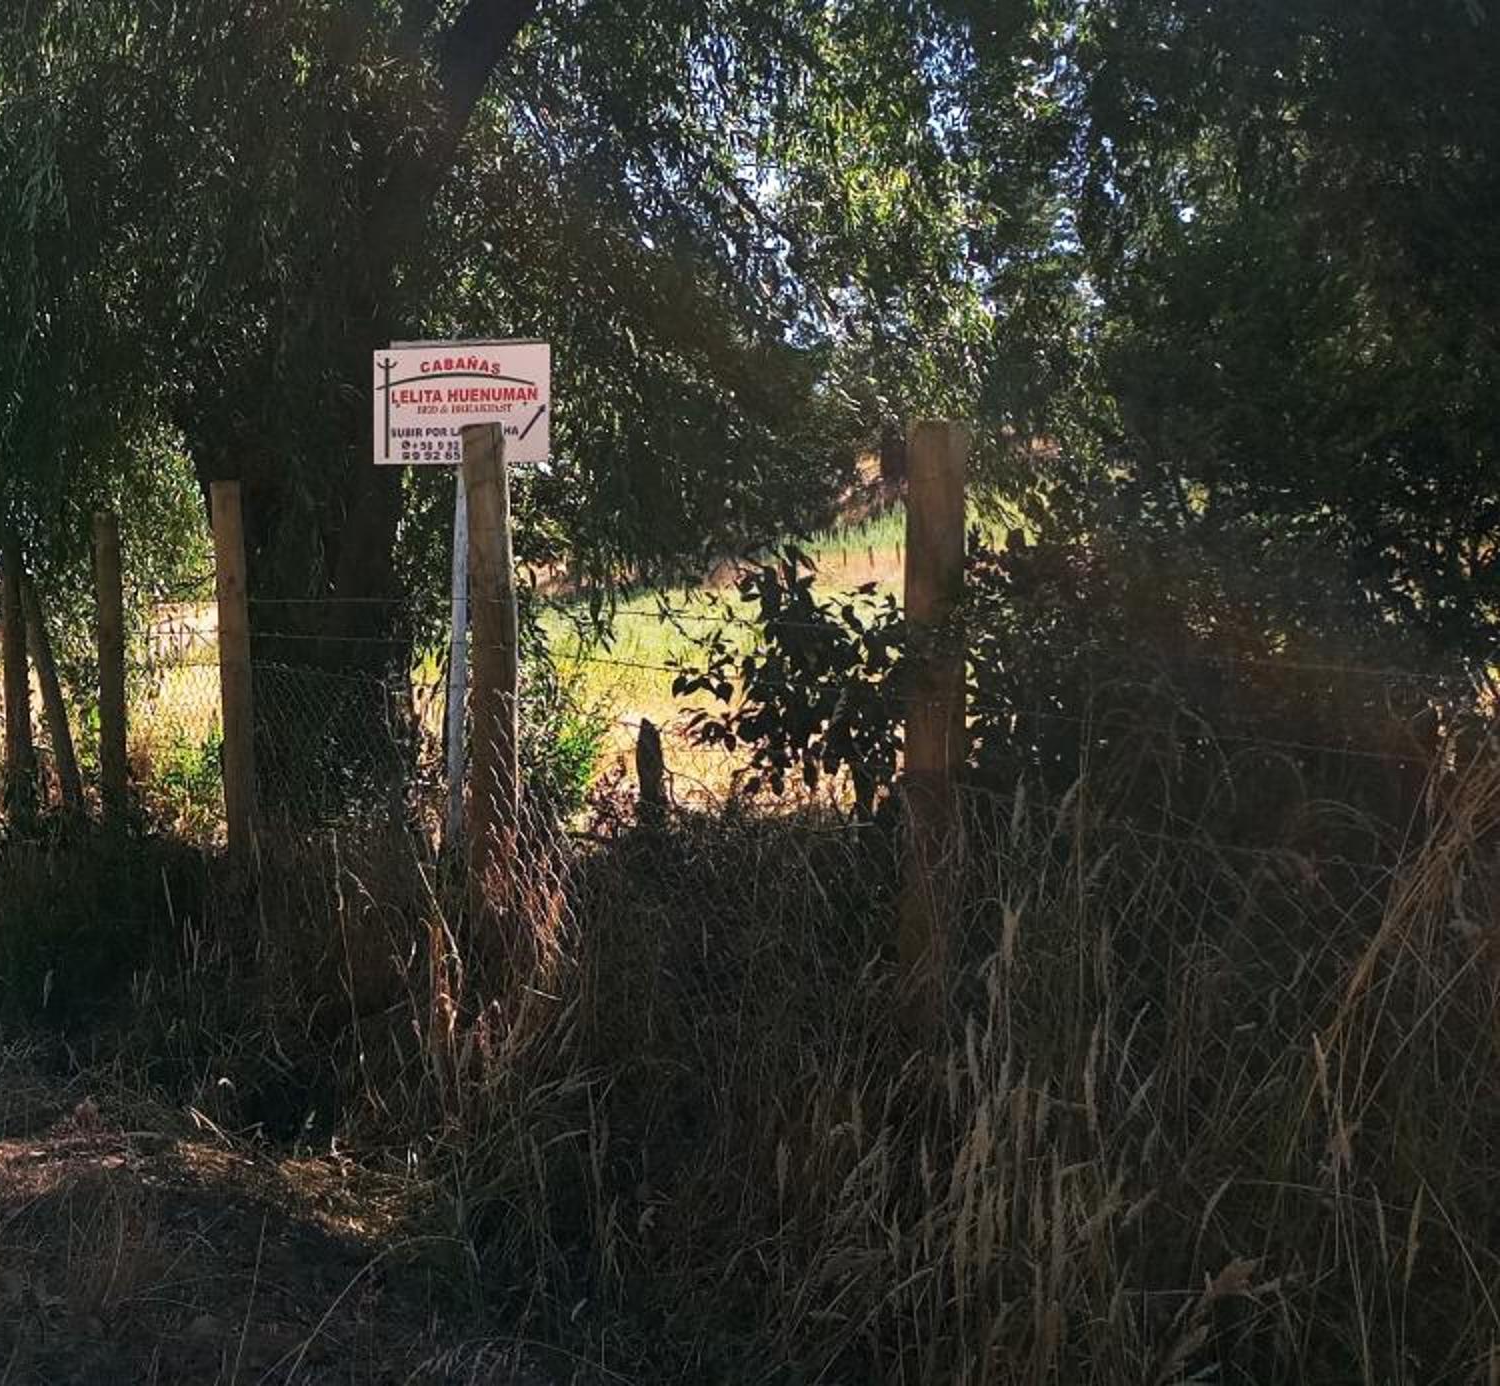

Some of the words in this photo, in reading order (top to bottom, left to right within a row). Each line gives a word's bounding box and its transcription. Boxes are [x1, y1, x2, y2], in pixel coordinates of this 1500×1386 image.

[420, 355, 501, 374] CABAÑAS
[391, 389, 443, 404] LELITA
[447, 387, 538, 402] HUENUMAN
[451, 403, 512, 413] BREAKFAST
[391, 427, 423, 438] SUBIR
[425, 426, 448, 437] POR
